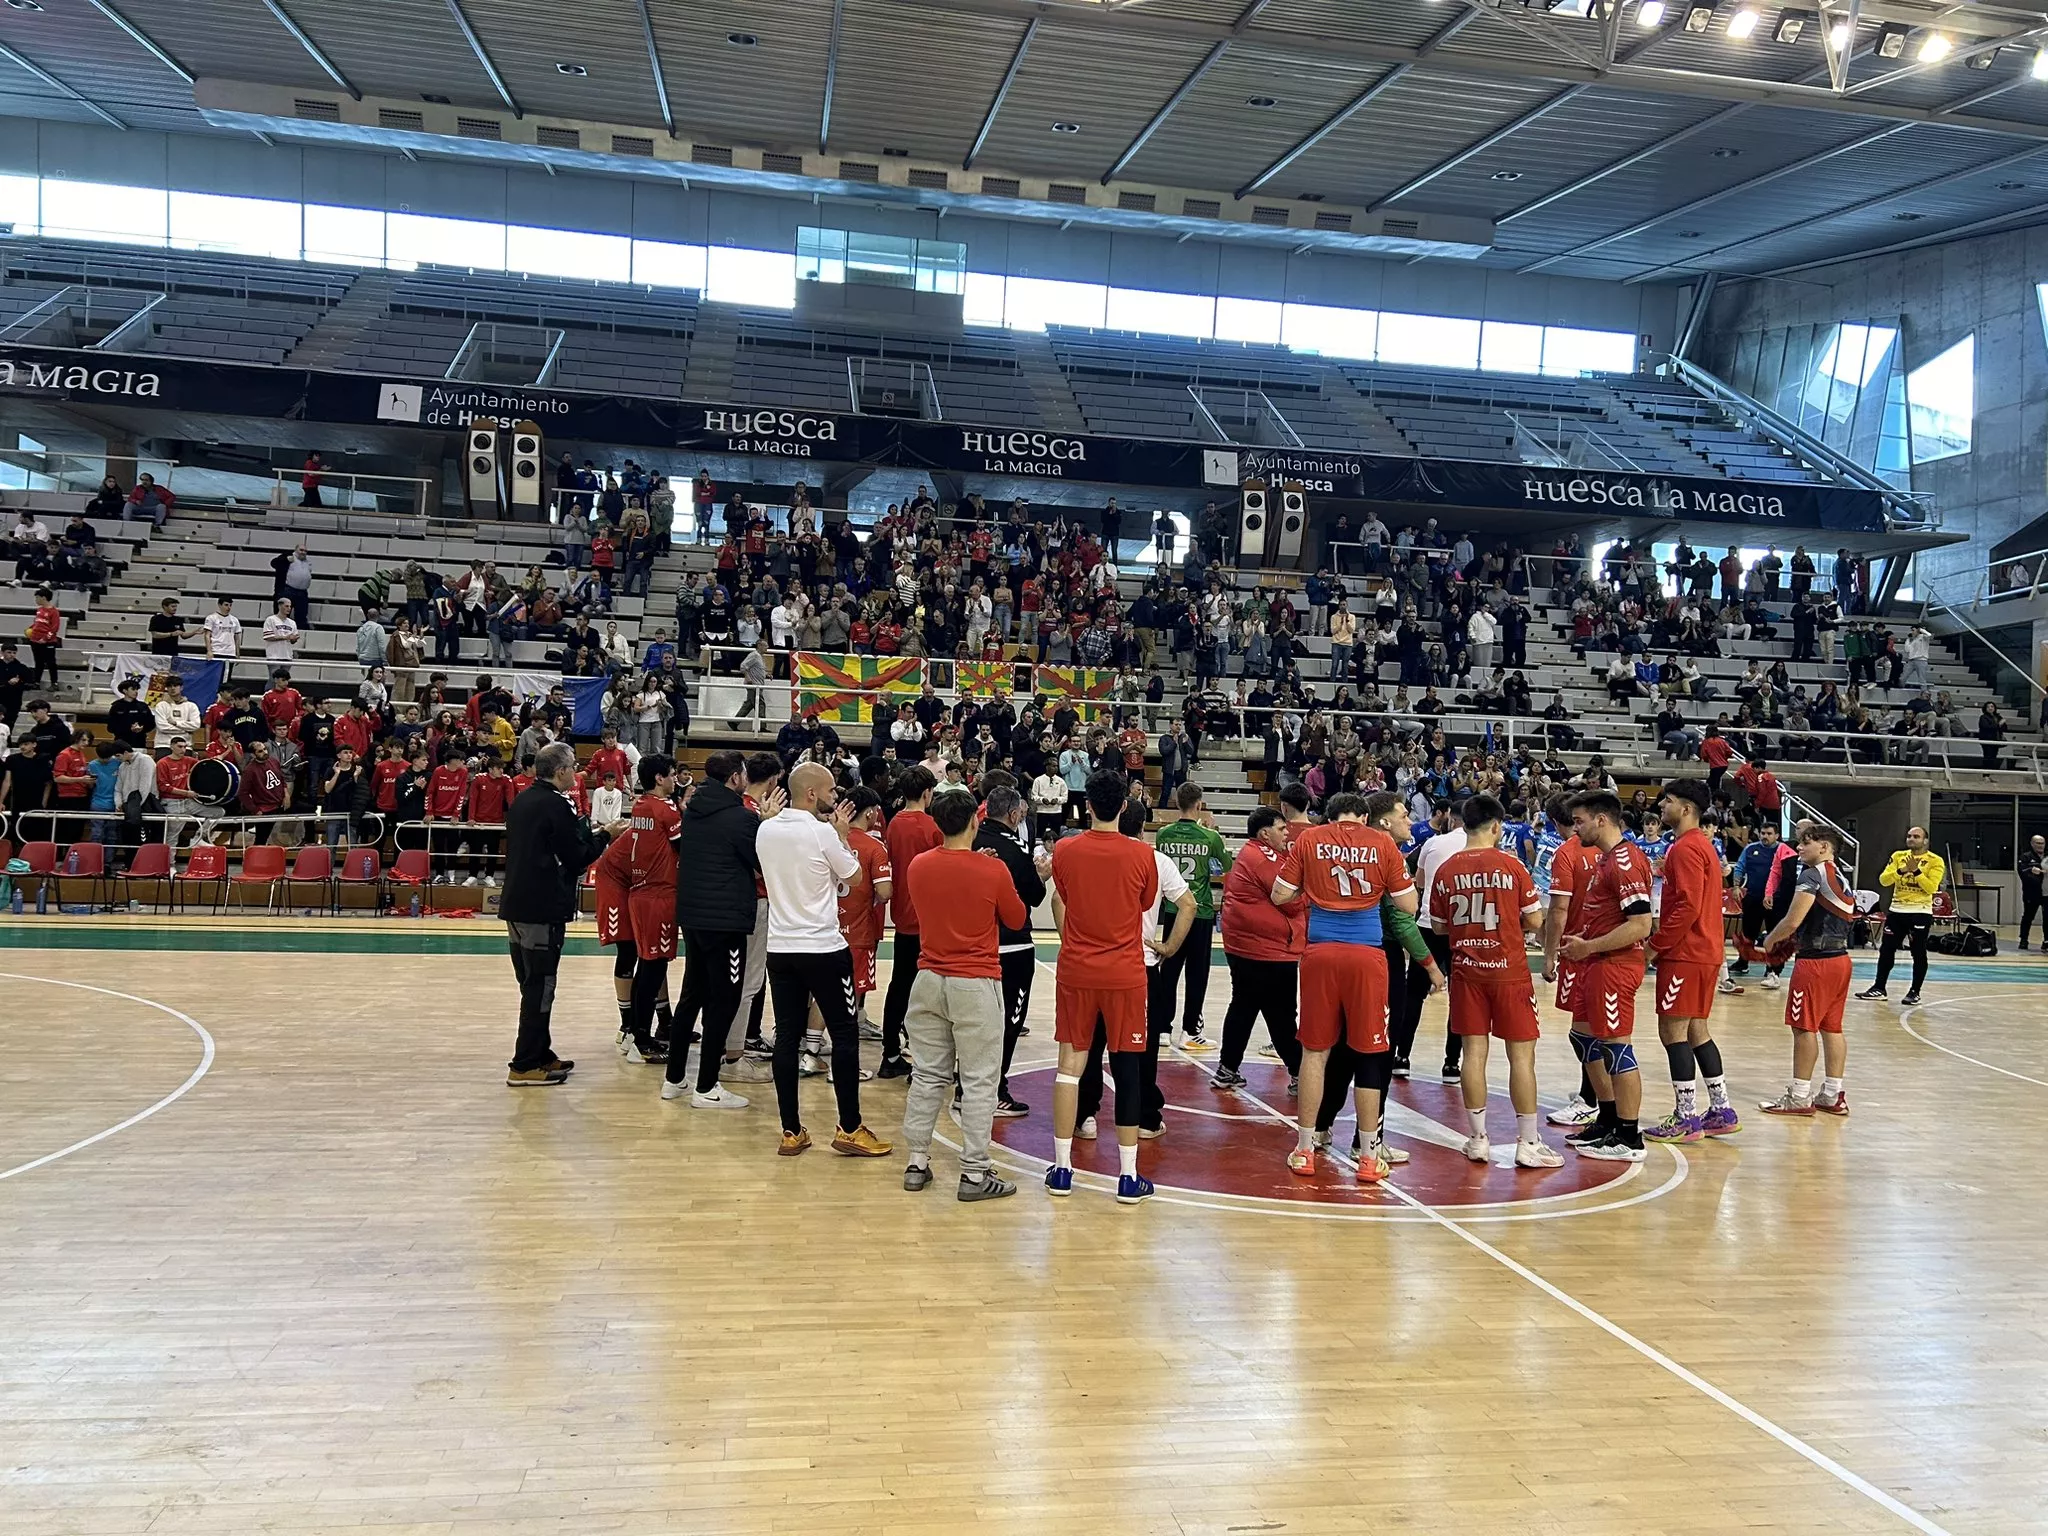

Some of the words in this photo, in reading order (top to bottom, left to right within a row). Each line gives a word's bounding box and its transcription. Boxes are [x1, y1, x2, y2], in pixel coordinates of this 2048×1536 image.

[429, 387, 569, 414] Ayuntamiento
[427, 409, 451, 425] de
[1245, 453, 1361, 475] Ayuntamiento
[1271, 473, 1334, 492] Hesca
[265, 769, 281, 790] A
[1159, 842, 1209, 856] CASTERAD
[1316, 843, 1378, 864] ESPARZA
[1331, 865, 1372, 896] 11
[1436, 880, 1450, 897] M.
[1454, 869, 1513, 891] INGLÁN
[1449, 892, 1499, 931] 24
